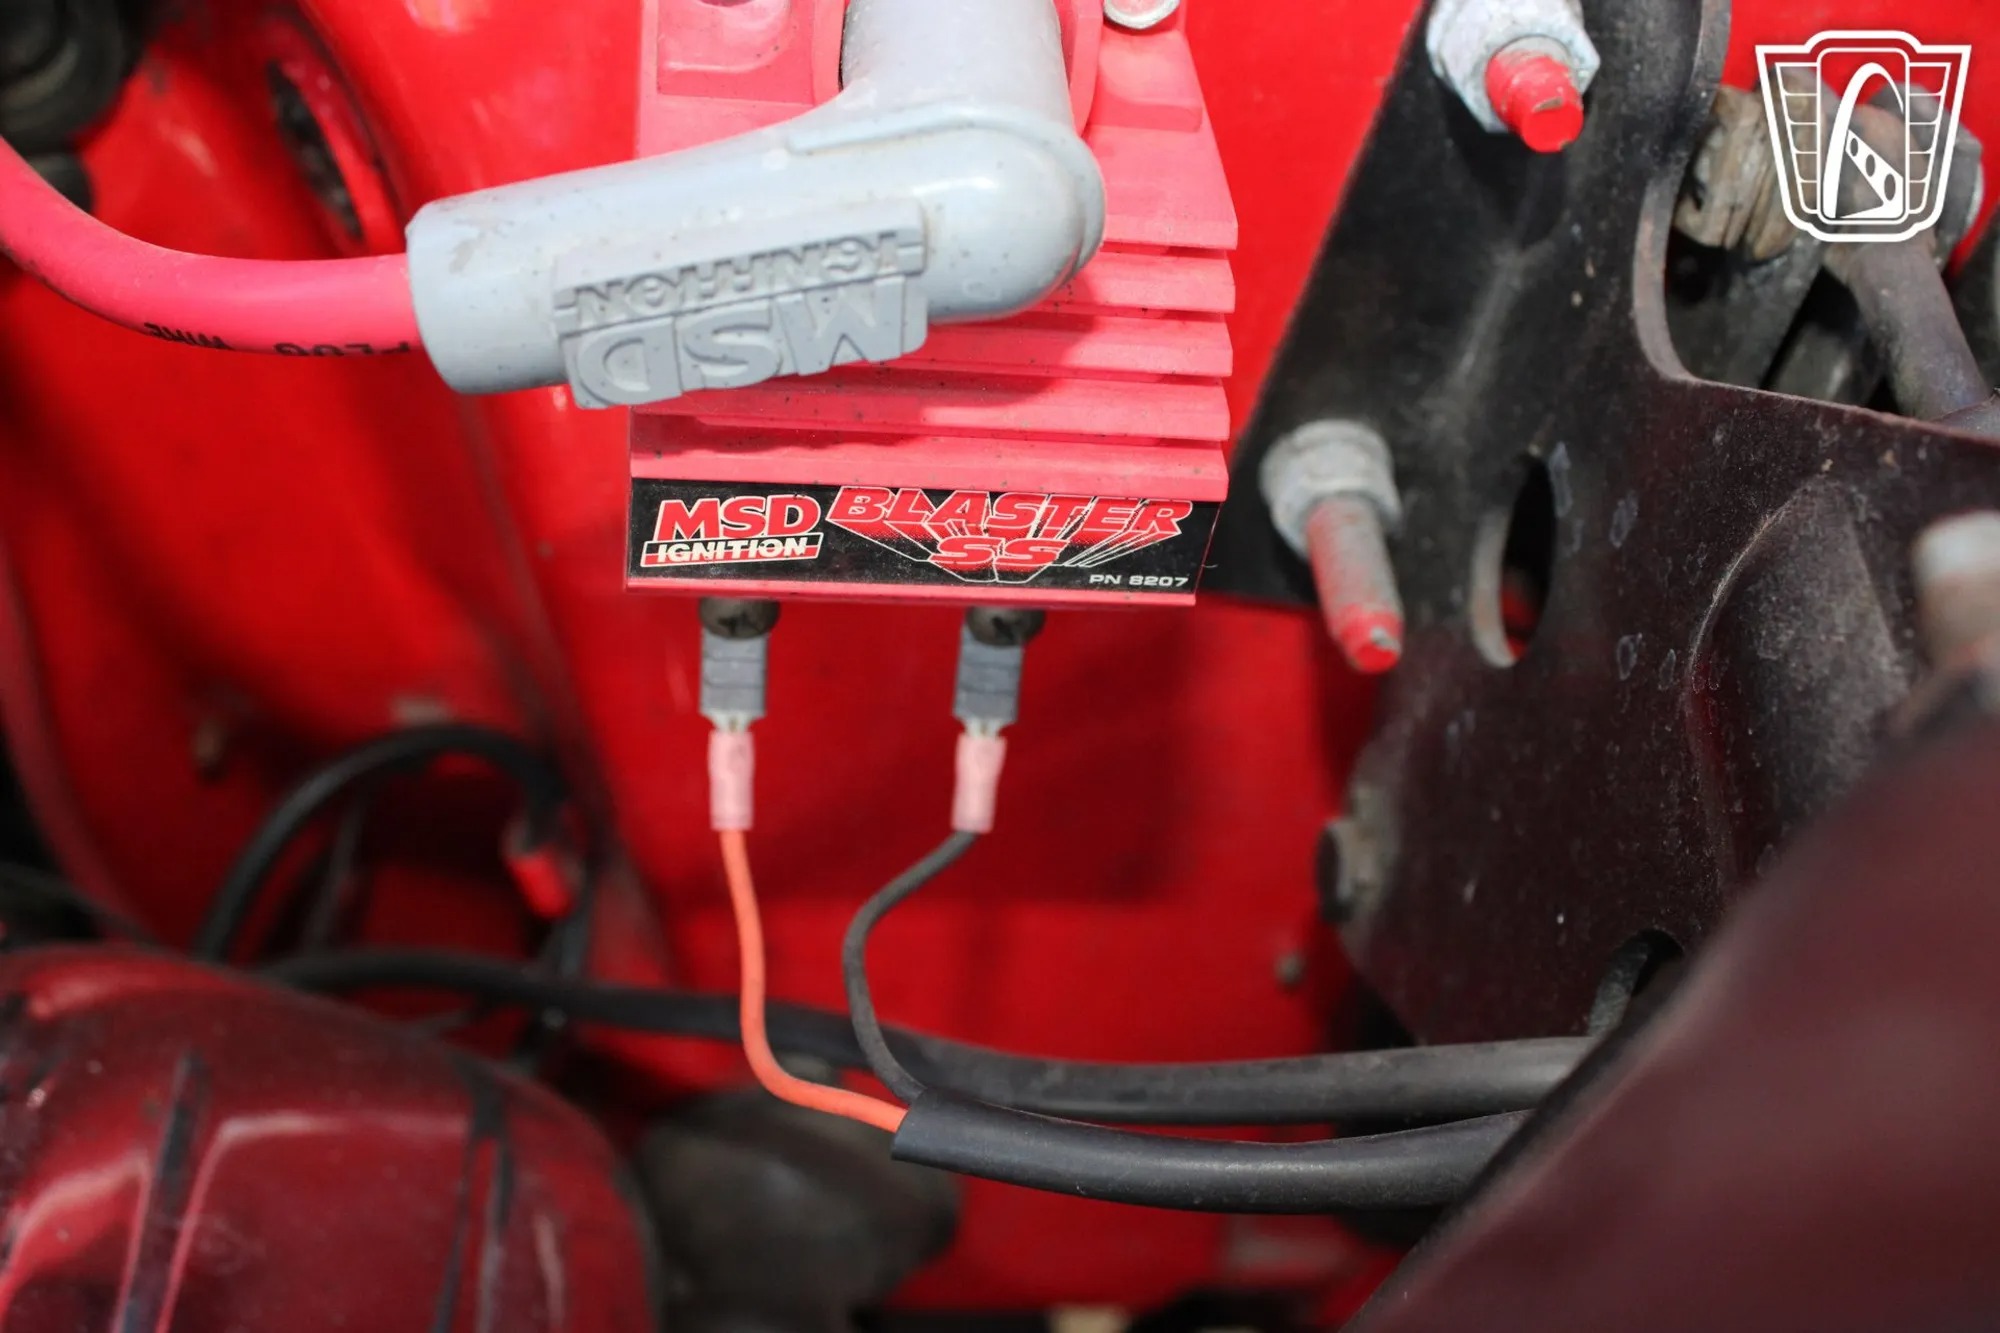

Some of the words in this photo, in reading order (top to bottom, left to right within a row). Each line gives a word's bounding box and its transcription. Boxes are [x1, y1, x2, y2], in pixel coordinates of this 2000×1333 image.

[572, 231, 899, 328] IGNITION
[576, 275, 906, 406] MSD
[653, 494, 822, 542] MSD
[826, 485, 1193, 534] BLASTER
[656, 536, 808, 563] IGNITION
[928, 535, 1071, 566] SS
[1089, 574, 1122, 585] PN
[1128, 575, 1189, 587] 8207
